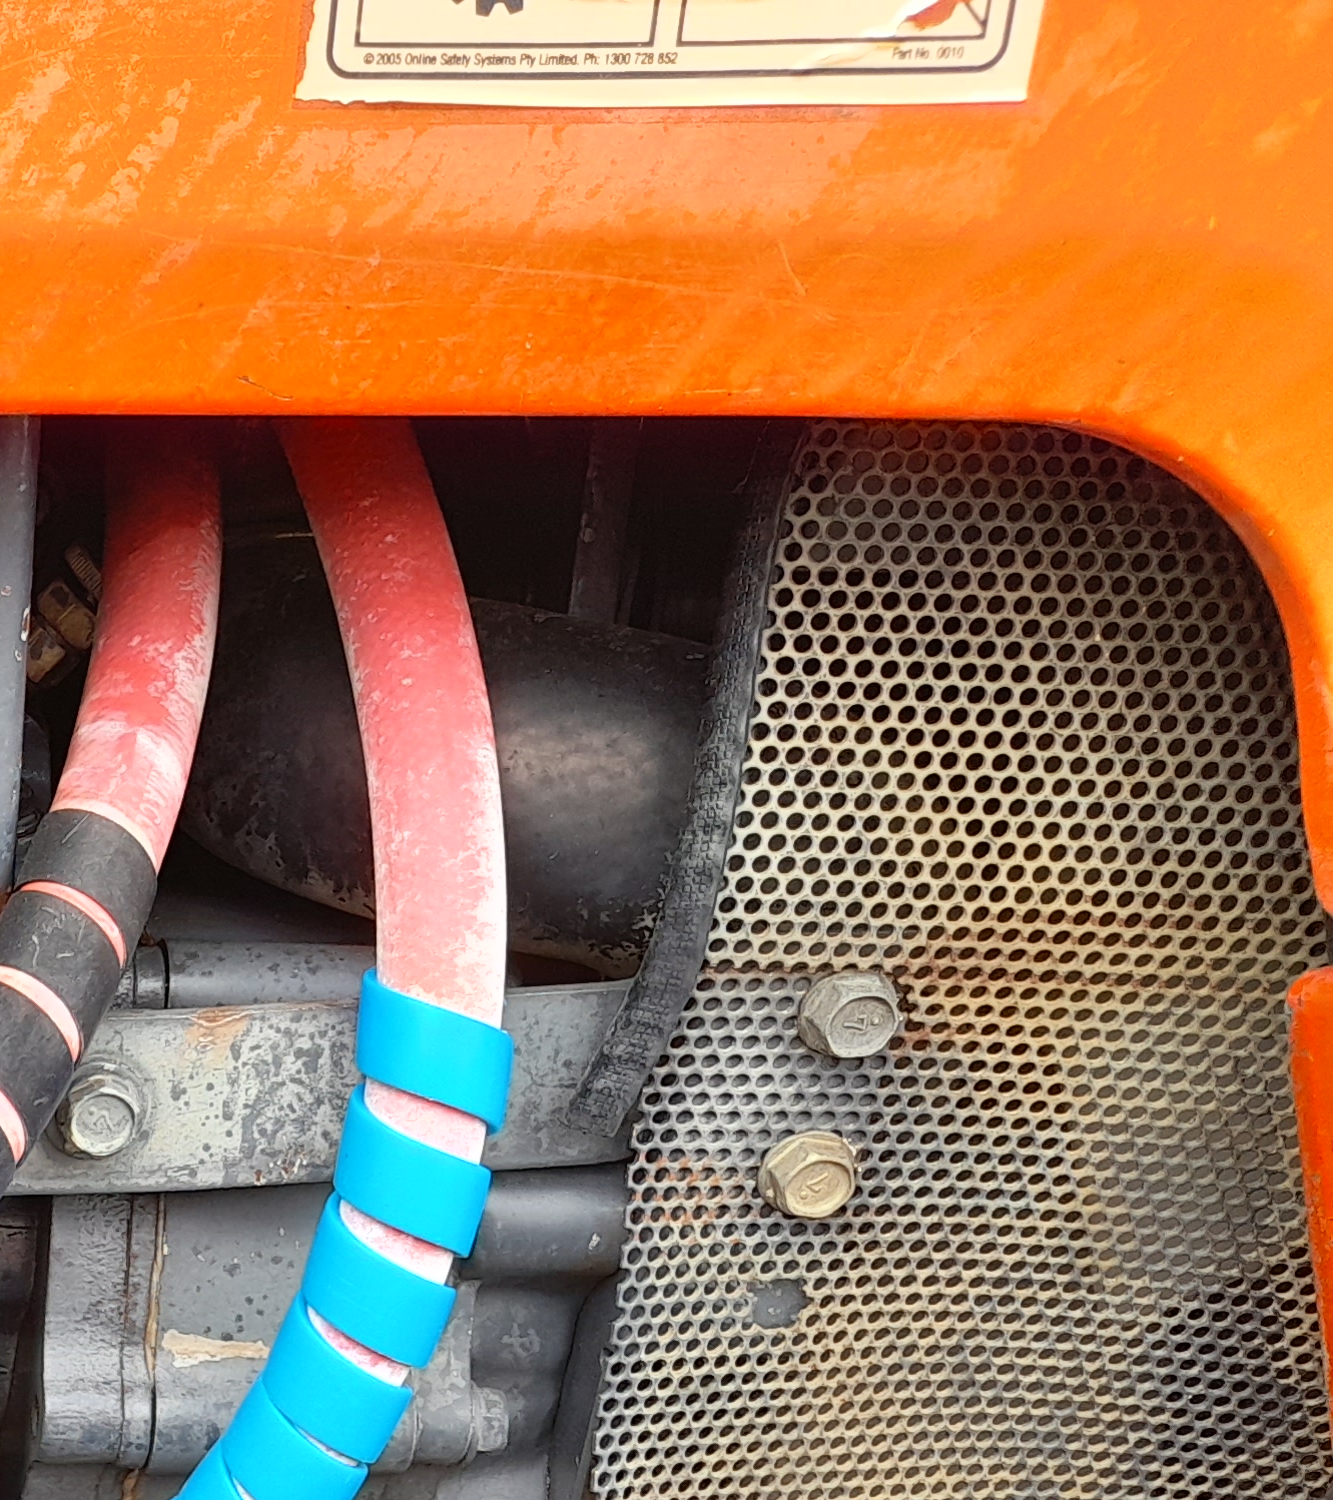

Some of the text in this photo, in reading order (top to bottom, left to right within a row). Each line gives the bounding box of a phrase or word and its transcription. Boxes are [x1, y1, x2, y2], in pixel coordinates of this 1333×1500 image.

[376, 53, 402, 65] 2005
[405, 53, 437, 65] Online
[440, 53, 471, 67] Safety
[474, 53, 516, 68] Systems
[519, 53, 536, 67] Pty
[605, 53, 631, 65] 1300
[634, 53, 654, 65] 728
[658, 52, 678, 65] 852
